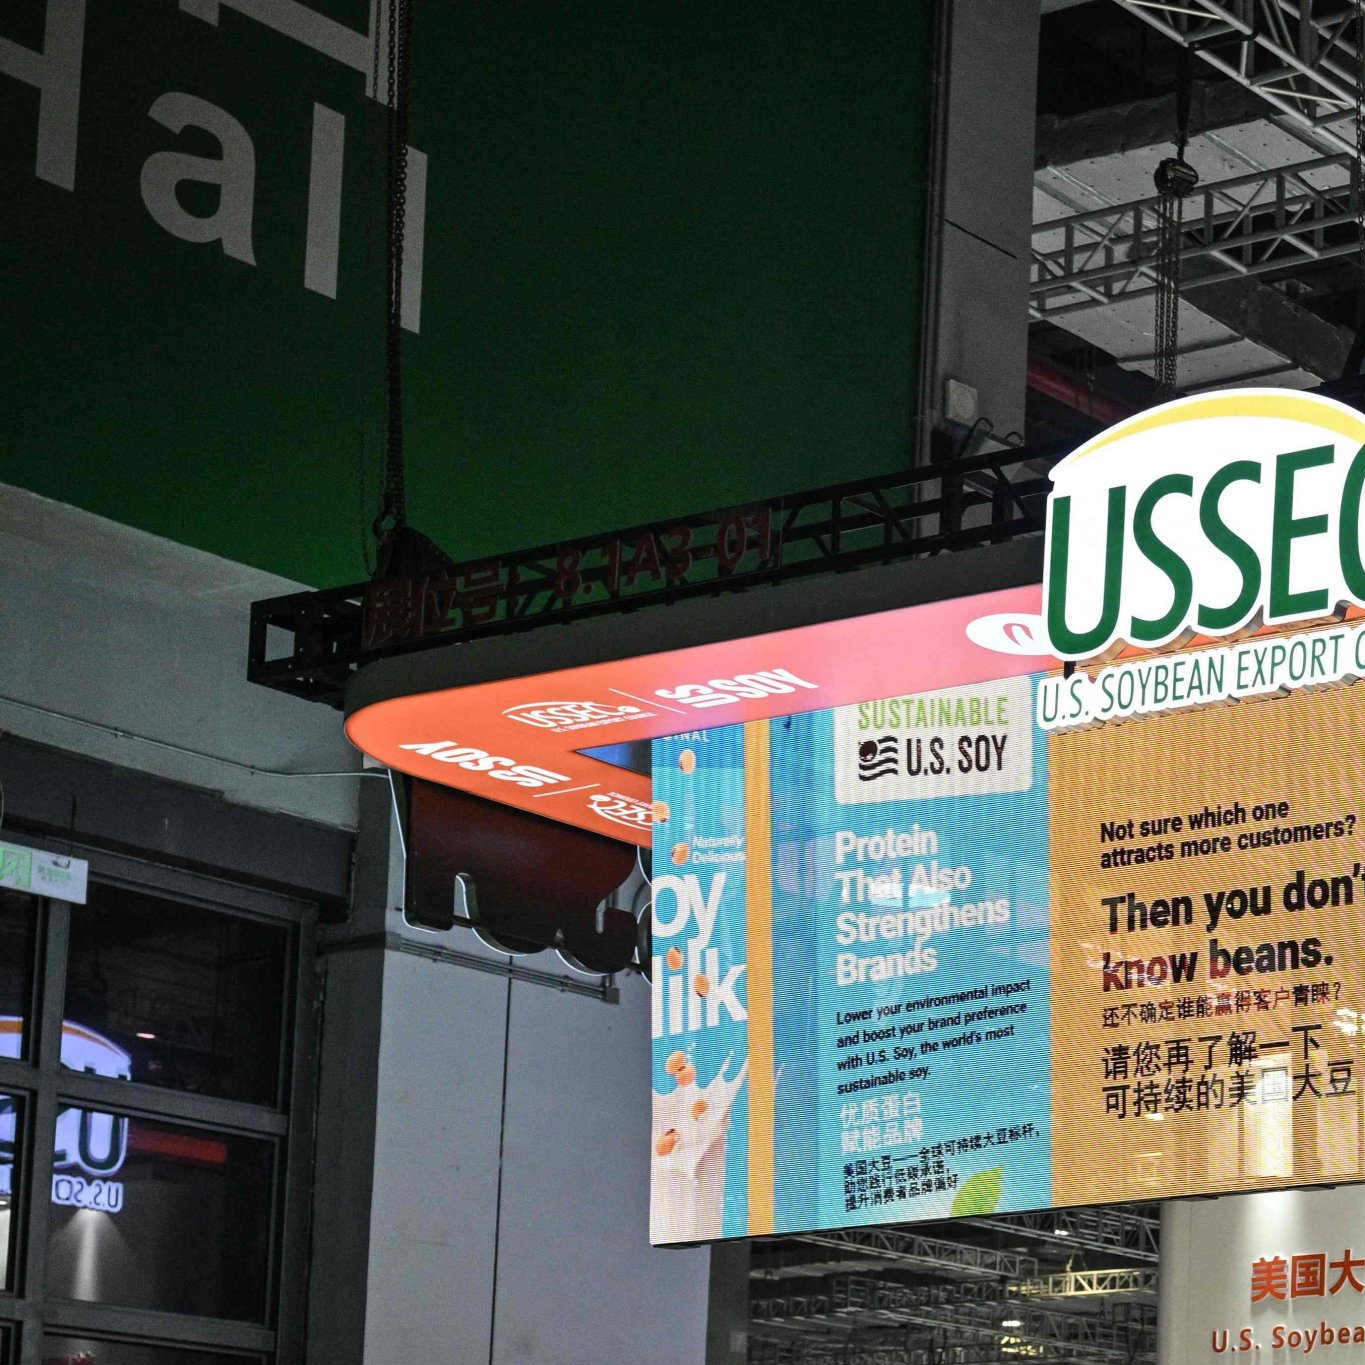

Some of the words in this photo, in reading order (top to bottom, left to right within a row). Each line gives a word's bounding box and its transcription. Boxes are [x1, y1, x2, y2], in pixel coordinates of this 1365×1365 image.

[1041, 683, 1090, 724] U.S.
[1100, 653, 1225, 714] SOYBEAN
[1237, 635, 1345, 691] EXPORT
[857, 696, 1009, 730] SUSTAINABLE
[906, 736, 950, 776] U.S.
[958, 734, 1007, 773] SOY
[692, 835, 745, 849] Naturally
[835, 823, 939, 865] Protein
[1100, 820, 1135, 844] Not
[1139, 814, 1183, 835] sure
[1189, 801, 1246, 830] which
[1252, 800, 1290, 820] one
[1100, 842, 1175, 869] attracts
[1180, 835, 1232, 859] more
[1237, 813, 1357, 851] customers?
[692, 851, 746, 864] Delicious
[835, 869, 903, 905] That
[908, 861, 973, 896] Also
[835, 898, 1011, 945] Strengthens
[1101, 893, 1194, 935] Then
[1203, 884, 1271, 933] you
[835, 940, 938, 986] Brands
[1102, 951, 1200, 993] know
[1209, 937, 1334, 979] beans.
[836, 1009, 873, 1026] Lower
[876, 1004, 902, 1021] your
[906, 985, 988, 1013] environmental
[991, 979, 1031, 997] impact
[837, 1033, 860, 1049] and
[862, 1026, 897, 1044] boost
[899, 1023, 925, 1040] your
[928, 1015, 961, 1032] brand
[964, 1002, 1027, 1027] preference
[837, 1056, 863, 1072] with
[866, 1049, 889, 1066] U.S.
[893, 1046, 917, 1061] Soy,
[920, 1041, 939, 1054] the
[941, 1033, 982, 1051] world's
[985, 1025, 1015, 1041] most
[1102, 1023, 1324, 1081] 请您再了解一下
[837, 1071, 906, 1094] sustainable
[909, 1065, 932, 1080] soy.
[1102, 1060, 1356, 1120] 可持续的美国大豆
[839, 1091, 922, 1126] 优质蛋白
[841, 1118, 923, 1155] 赋能品牌
[1212, 1327, 1262, 1354] U.S.
